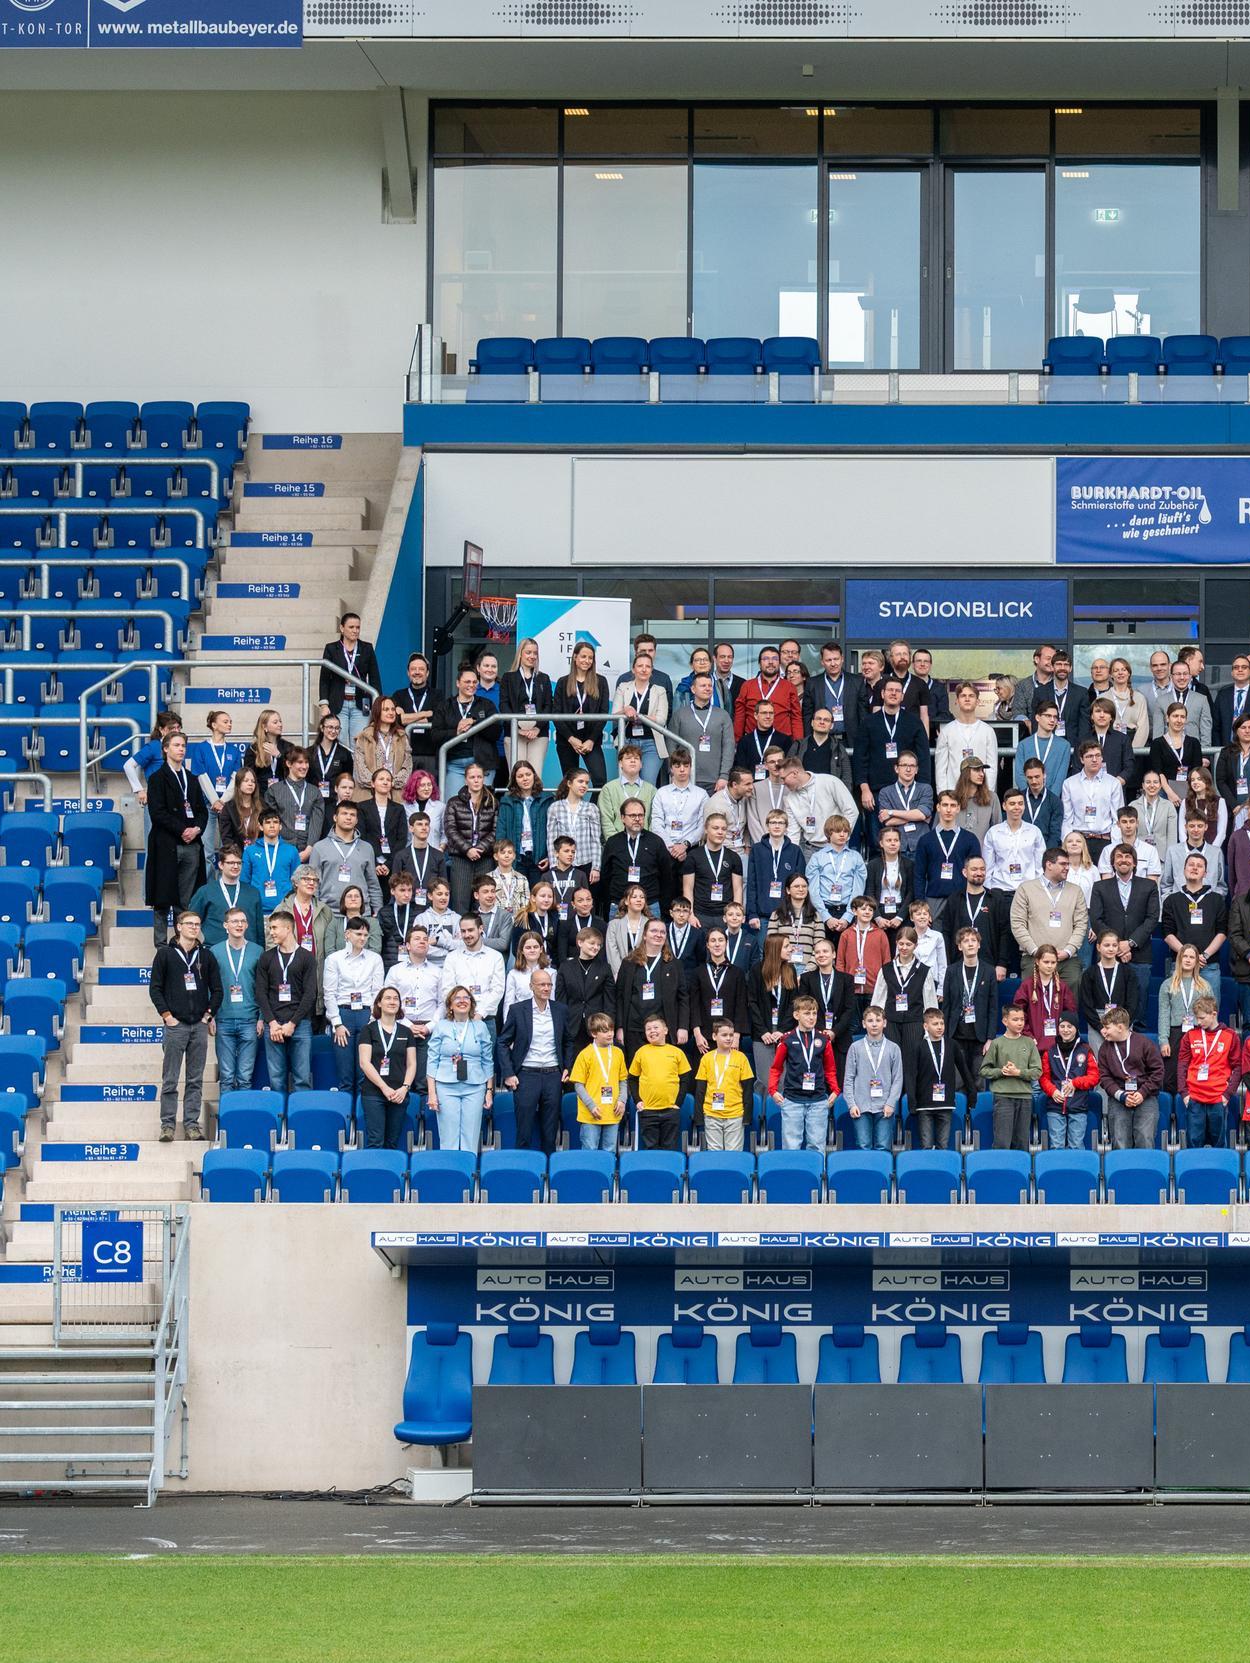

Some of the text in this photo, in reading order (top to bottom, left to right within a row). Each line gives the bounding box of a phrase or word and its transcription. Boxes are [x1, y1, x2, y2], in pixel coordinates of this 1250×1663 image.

[293, 436, 333, 444] Reihe 16
[274, 484, 315, 492] Reihe 15
[1071, 486, 1204, 499] BURKHARDT-OIL
[1071, 501, 1199, 510] Schmierstoffe und Zubehör
[1129, 515, 1154, 526] dann
[1158, 512, 1191, 523] läuft's
[1122, 525, 1200, 540] wie geschmiert
[262, 534, 303, 542] Reihe 14
[248, 585, 290, 593] Reihe 13
[879, 602, 1032, 617] STADIONBLICK
[233, 637, 276, 645] Reihe 12
[218, 689, 260, 698] Reihe 11
[64, 800, 103, 809] Reie 9
[122, 1028, 163, 1037] Reihe 5
[103, 1087, 145, 1096] Reihe 4
[85, 1146, 127, 1155] Reihe 3
[462, 1233, 537, 1246] KÖNIG
[634, 1233, 708, 1246] KÖNIG
[804, 1233, 879, 1246] KÖNIG
[976, 1233, 1050, 1246] KÖNIG
[1144, 1233, 1218, 1246] KÖNIG
[93, 1241, 132, 1264] C8
[43, 1267, 76, 1277] Rhe
[482, 1276, 610, 1285] AUTO HAUS
[680, 1276, 807, 1285] AUTO HAUS
[878, 1276, 1005, 1285] AUTO HAUS
[1076, 1276, 1203, 1285] AUTO HAUS
[476, 1297, 614, 1321] KÖNIG
[674, 1297, 812, 1321] KÖNIG
[872, 1297, 1010, 1321] KÖNIG
[1070, 1297, 1208, 1321] KÖNIG
